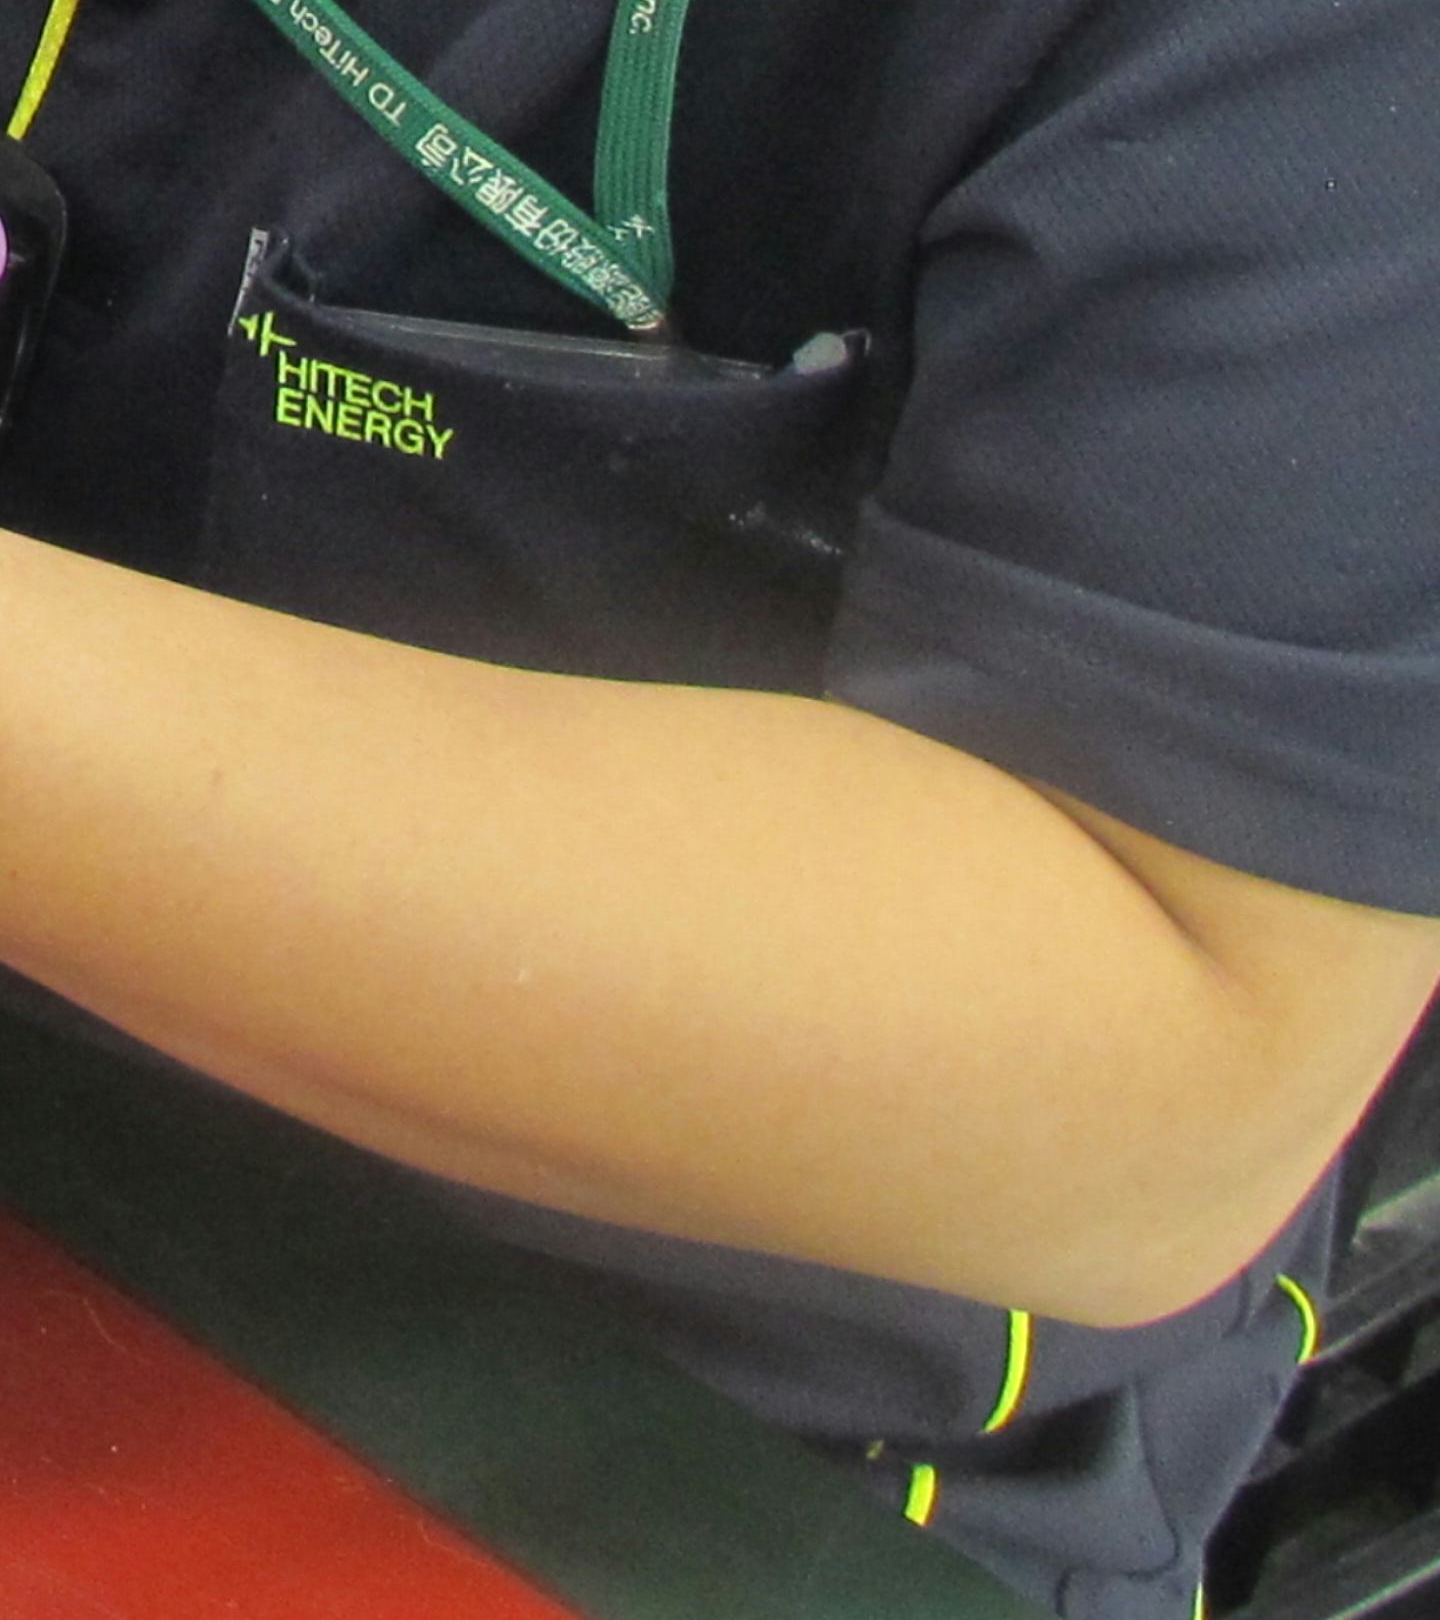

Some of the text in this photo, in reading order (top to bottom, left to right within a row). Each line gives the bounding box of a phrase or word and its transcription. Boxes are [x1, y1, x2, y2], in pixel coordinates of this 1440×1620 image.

[368, 82, 408, 127] TD
[277, 349, 435, 422] HITECH
[275, 387, 455, 460] ENERGY
